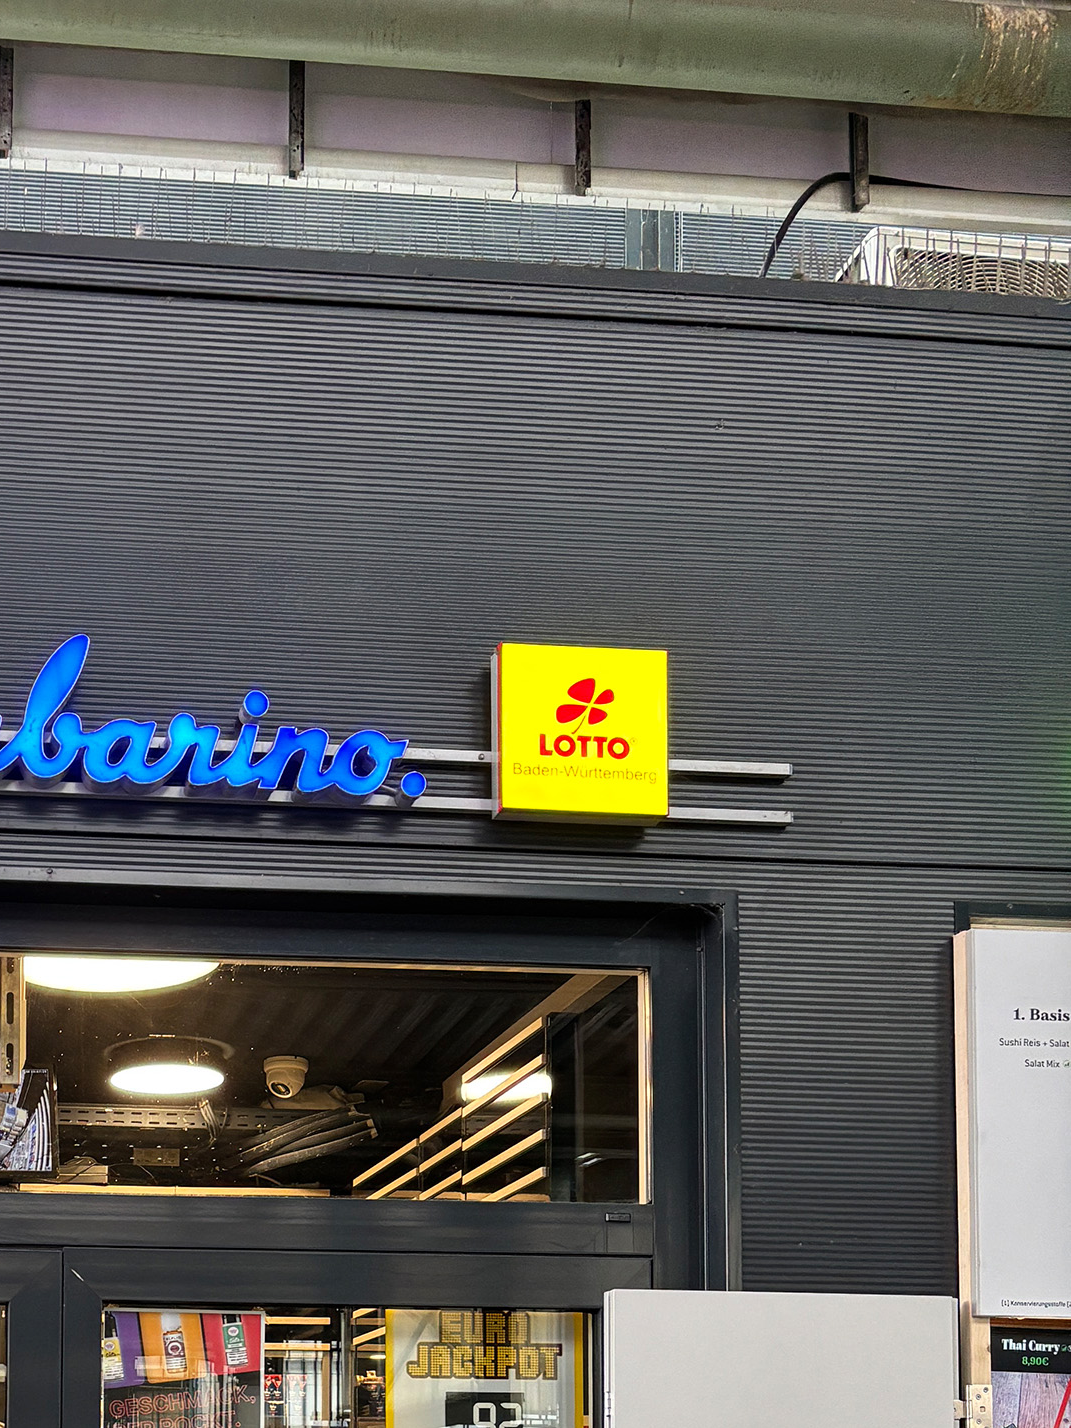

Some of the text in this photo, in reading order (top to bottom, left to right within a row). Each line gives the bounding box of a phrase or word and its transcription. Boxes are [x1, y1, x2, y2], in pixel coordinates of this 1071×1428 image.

[539, 733, 630, 760] LOTTO
[512, 762, 658, 785] Baden-Württemberg
[1014, 1008, 1070, 1022] 1. Basis
[999, 1038, 1022, 1046] Sushi
[1024, 1038, 1040, 1047] Reis
[1049, 1039, 1070, 1048] Salat
[1024, 1058, 1045, 1068] Salat
[440, 1311, 529, 1344] EURO
[1002, 1338, 1060, 1355] Thai Curry
[407, 1344, 560, 1378] JACKPOT
[1022, 1356, 1049, 1367] 8,90€
